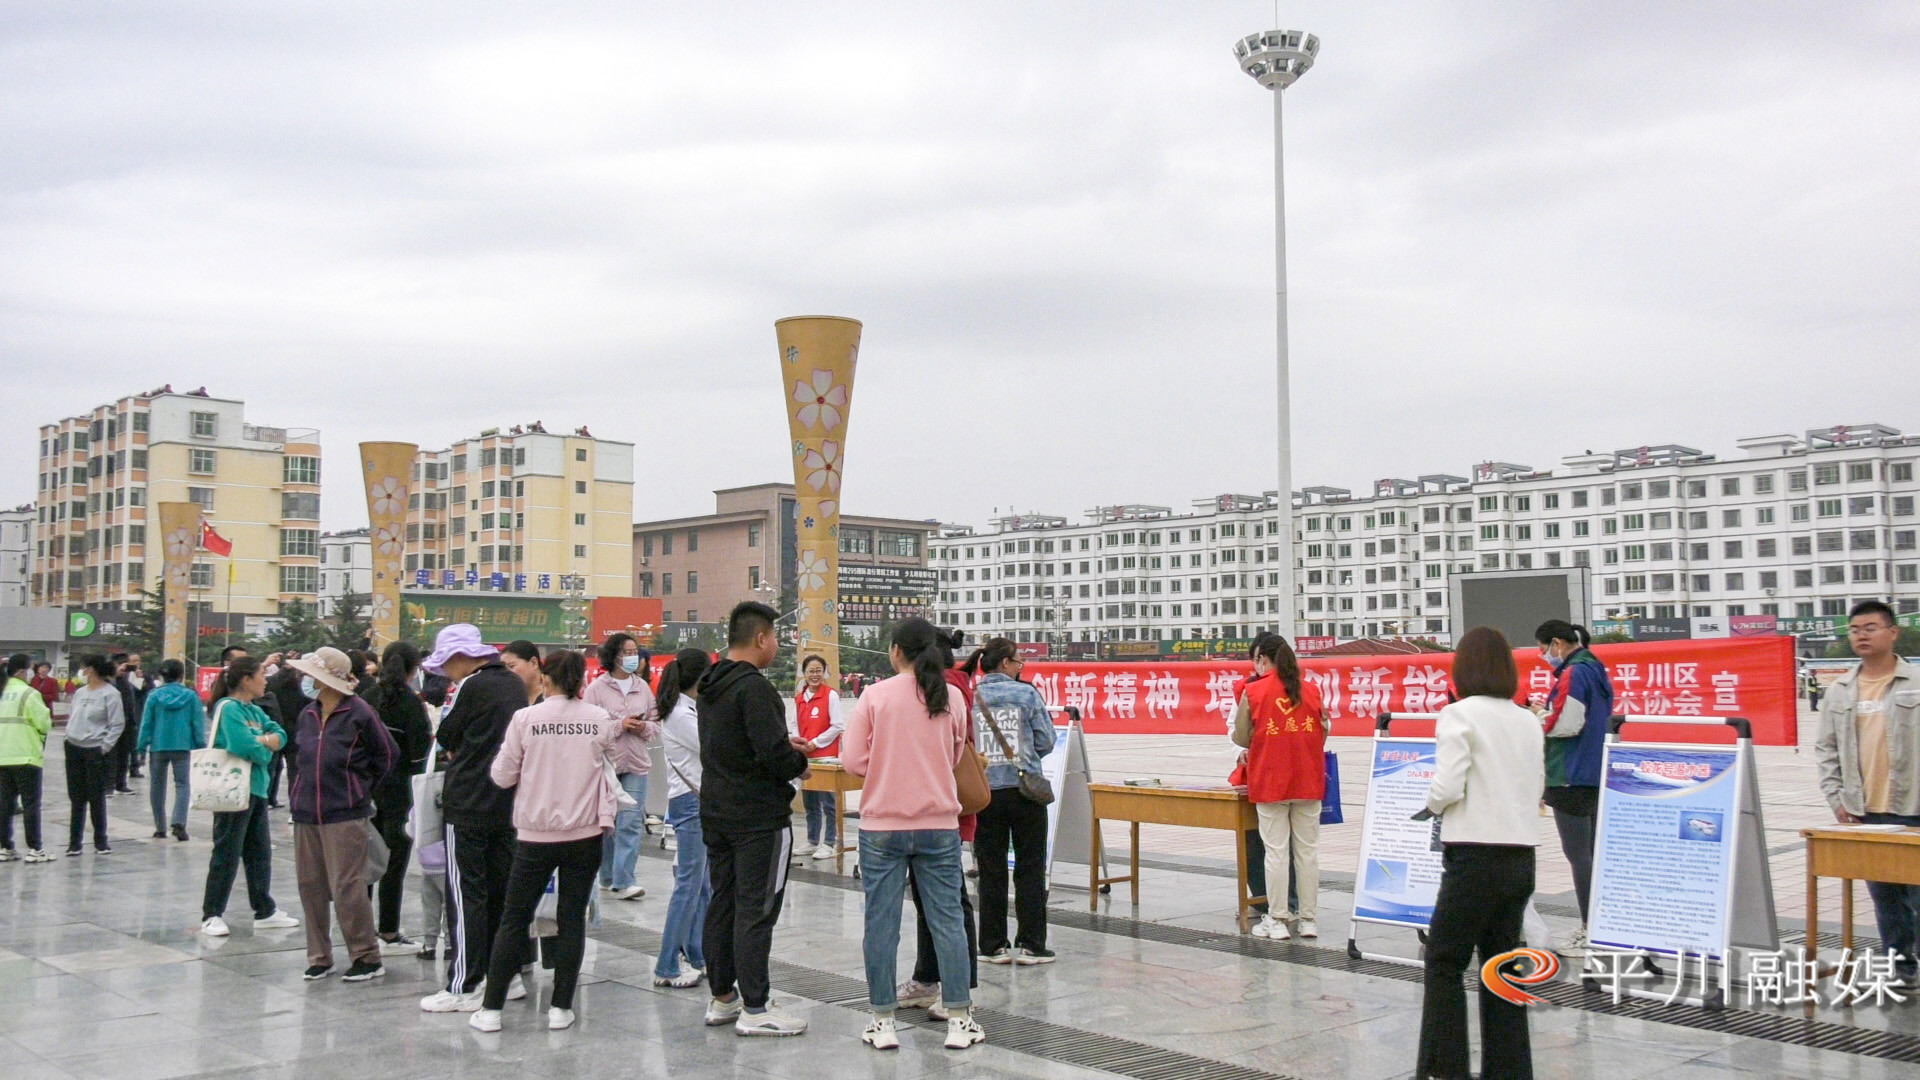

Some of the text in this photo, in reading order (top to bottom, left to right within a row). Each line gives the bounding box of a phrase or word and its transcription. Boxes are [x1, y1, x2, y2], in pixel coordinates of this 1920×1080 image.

[1032, 671, 1180, 719] 创新精神
[1711, 671, 1741, 712] 宣
[532, 723, 599, 736] NARCISSUS
[1265, 716, 1314, 736] 志愿者
